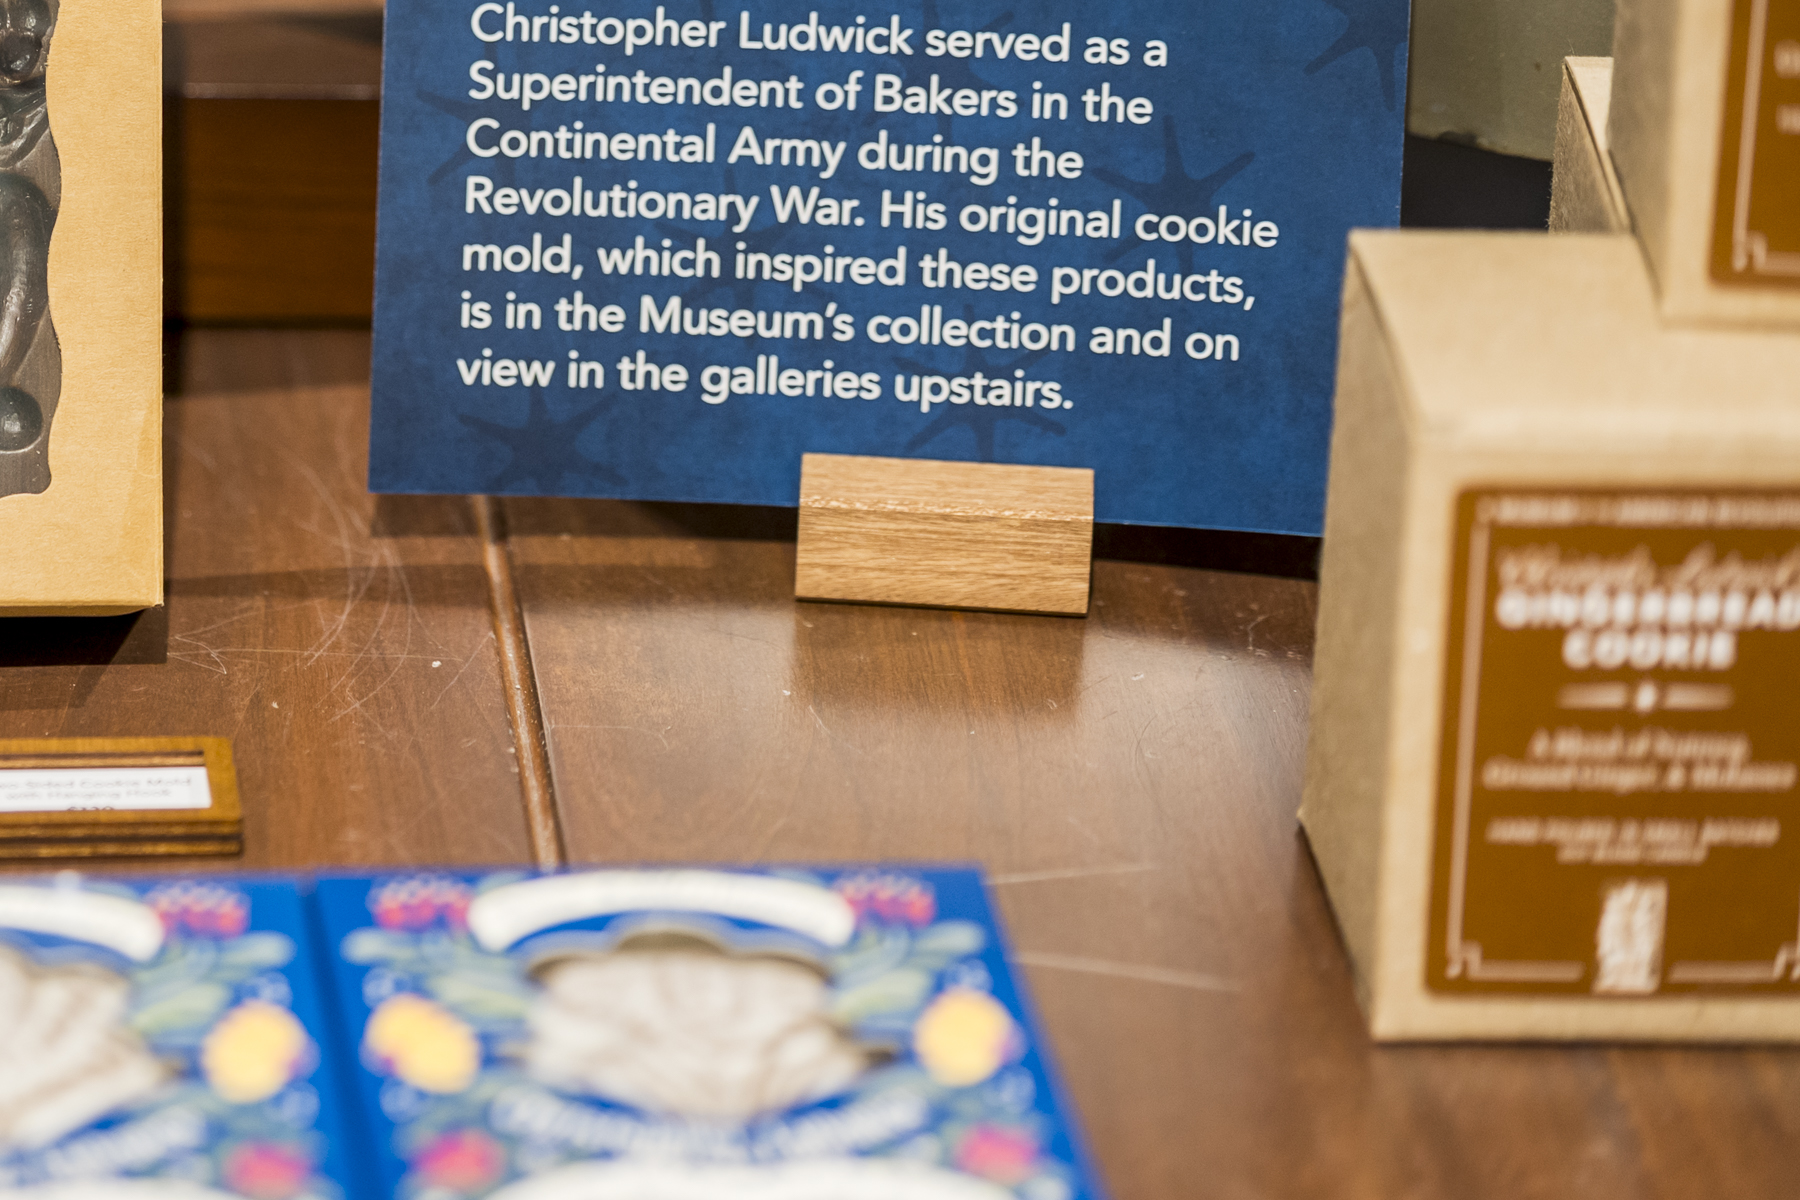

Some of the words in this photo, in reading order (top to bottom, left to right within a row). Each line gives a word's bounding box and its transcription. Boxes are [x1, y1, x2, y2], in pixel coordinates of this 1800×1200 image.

[471, 2, 726, 55] Christopher
[740, 11, 913, 55] Ludwick
[926, 22, 1070, 62] served
[1084, 37, 1130, 65] as
[1143, 40, 1167, 66] a
[469, 60, 804, 110] Superintendent
[816, 70, 864, 110] of
[874, 74, 1017, 117] Bakers
[1032, 81, 1067, 120] in
[1082, 82, 1153, 124] the
[467, 118, 715, 163] Continental
[728, 126, 846, 179] Army
[858, 130, 999, 185] during
[1012, 137, 1083, 178] the
[466, 176, 759, 233] Revolutionary
[770, 185, 864, 226] War.
[881, 190, 947, 230] His
[960, 196, 1121, 245] original
[1135, 205, 1279, 247] cookie
[463, 233, 583, 280] mold,
[597, 235, 720, 278] which
[736, 241, 906, 292] inspired
[919, 248, 1038, 292] these
[1052, 259, 1254, 310] products,
[461, 291, 492, 329] is
[506, 291, 541, 329] in
[554, 291, 626, 332] the
[867, 305, 1075, 351] collection
[1090, 318, 1171, 356] and
[1185, 333, 1239, 361] on
[457, 348, 555, 387] view
[568, 350, 604, 388] in
[617, 350, 688, 391] the
[701, 355, 881, 404] galleries
[895, 369, 1073, 413] upstairs.
[1562, 629, 1738, 671] COOKIE
